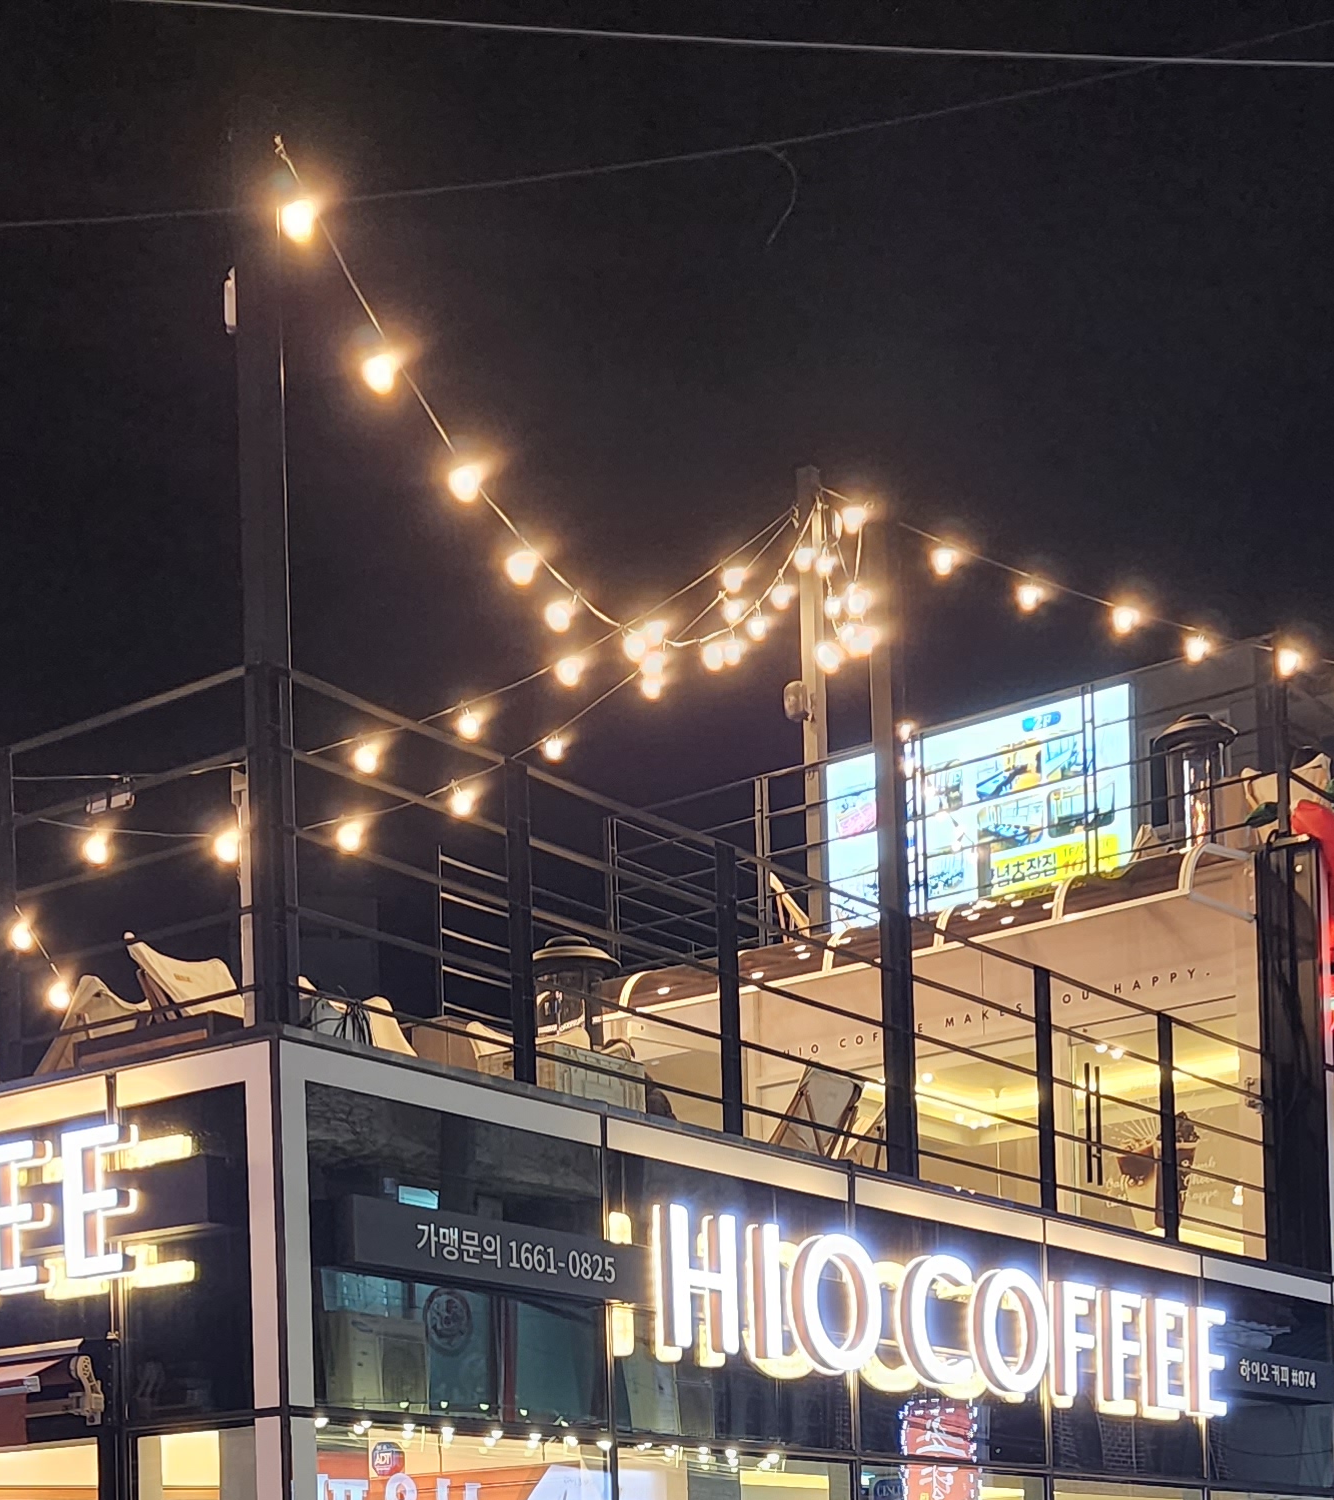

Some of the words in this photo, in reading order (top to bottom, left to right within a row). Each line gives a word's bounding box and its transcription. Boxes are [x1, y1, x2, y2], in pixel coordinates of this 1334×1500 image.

[990, 851, 1057, 888] 념초장집
[1063, 991, 1091, 1005] OU
[1114, 968, 1212, 994] HAPPY.
[417, 1223, 502, 1269] 가맹문의
[508, 1241, 616, 1284] 1661-0825
[653, 1203, 868, 1376] HIO
[901, 1254, 1227, 1415] COFFEE
[1239, 1358, 1270, 1383] 하이오
[1271, 1364, 1289, 1387] 커피
[1291, 1369, 1316, 1389] #074
[374, 1452, 392, 1467] ADT
